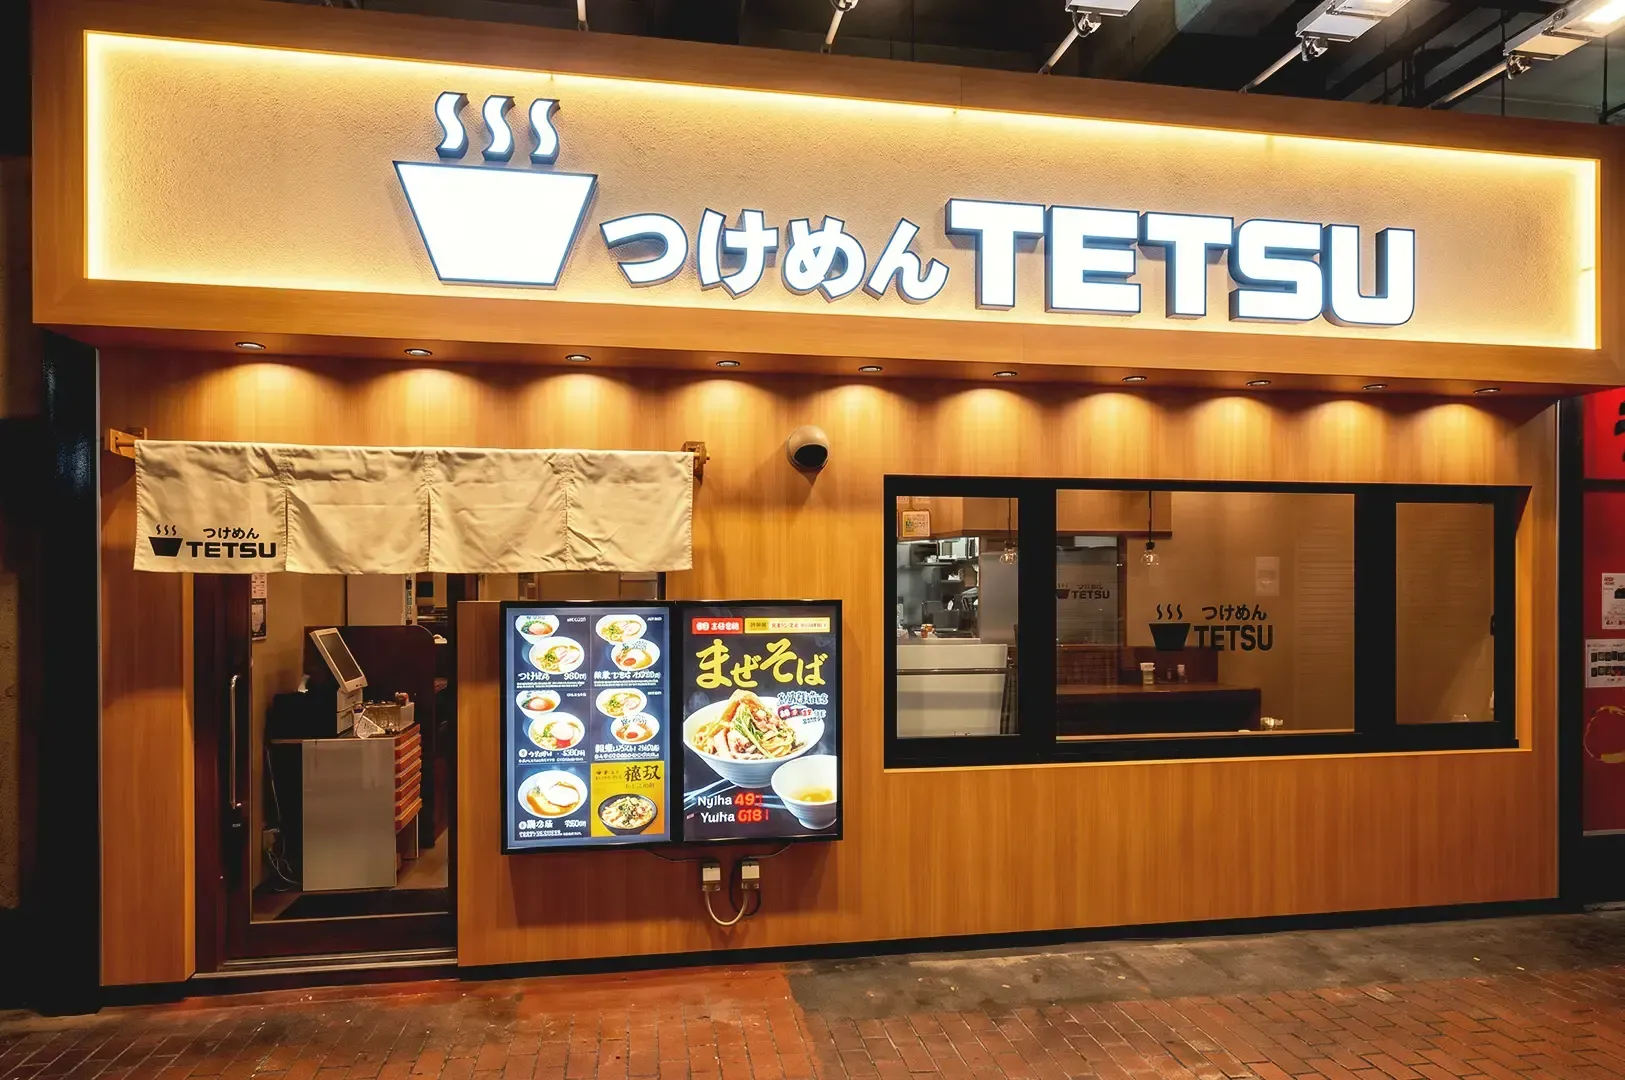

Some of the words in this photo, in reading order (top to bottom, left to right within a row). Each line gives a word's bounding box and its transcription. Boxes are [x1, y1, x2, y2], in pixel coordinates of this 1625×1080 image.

[599, 208, 949, 304] つけめん
[945, 198, 1415, 327] TETSU
[203, 527, 259, 539] つけめん
[186, 541, 277, 559] TETSU
[1071, 589, 1110, 600] TETSU
[1201, 604, 1267, 621] つけめん
[1194, 625, 1273, 651] TETSU
[695, 638, 829, 689] まぜそば
